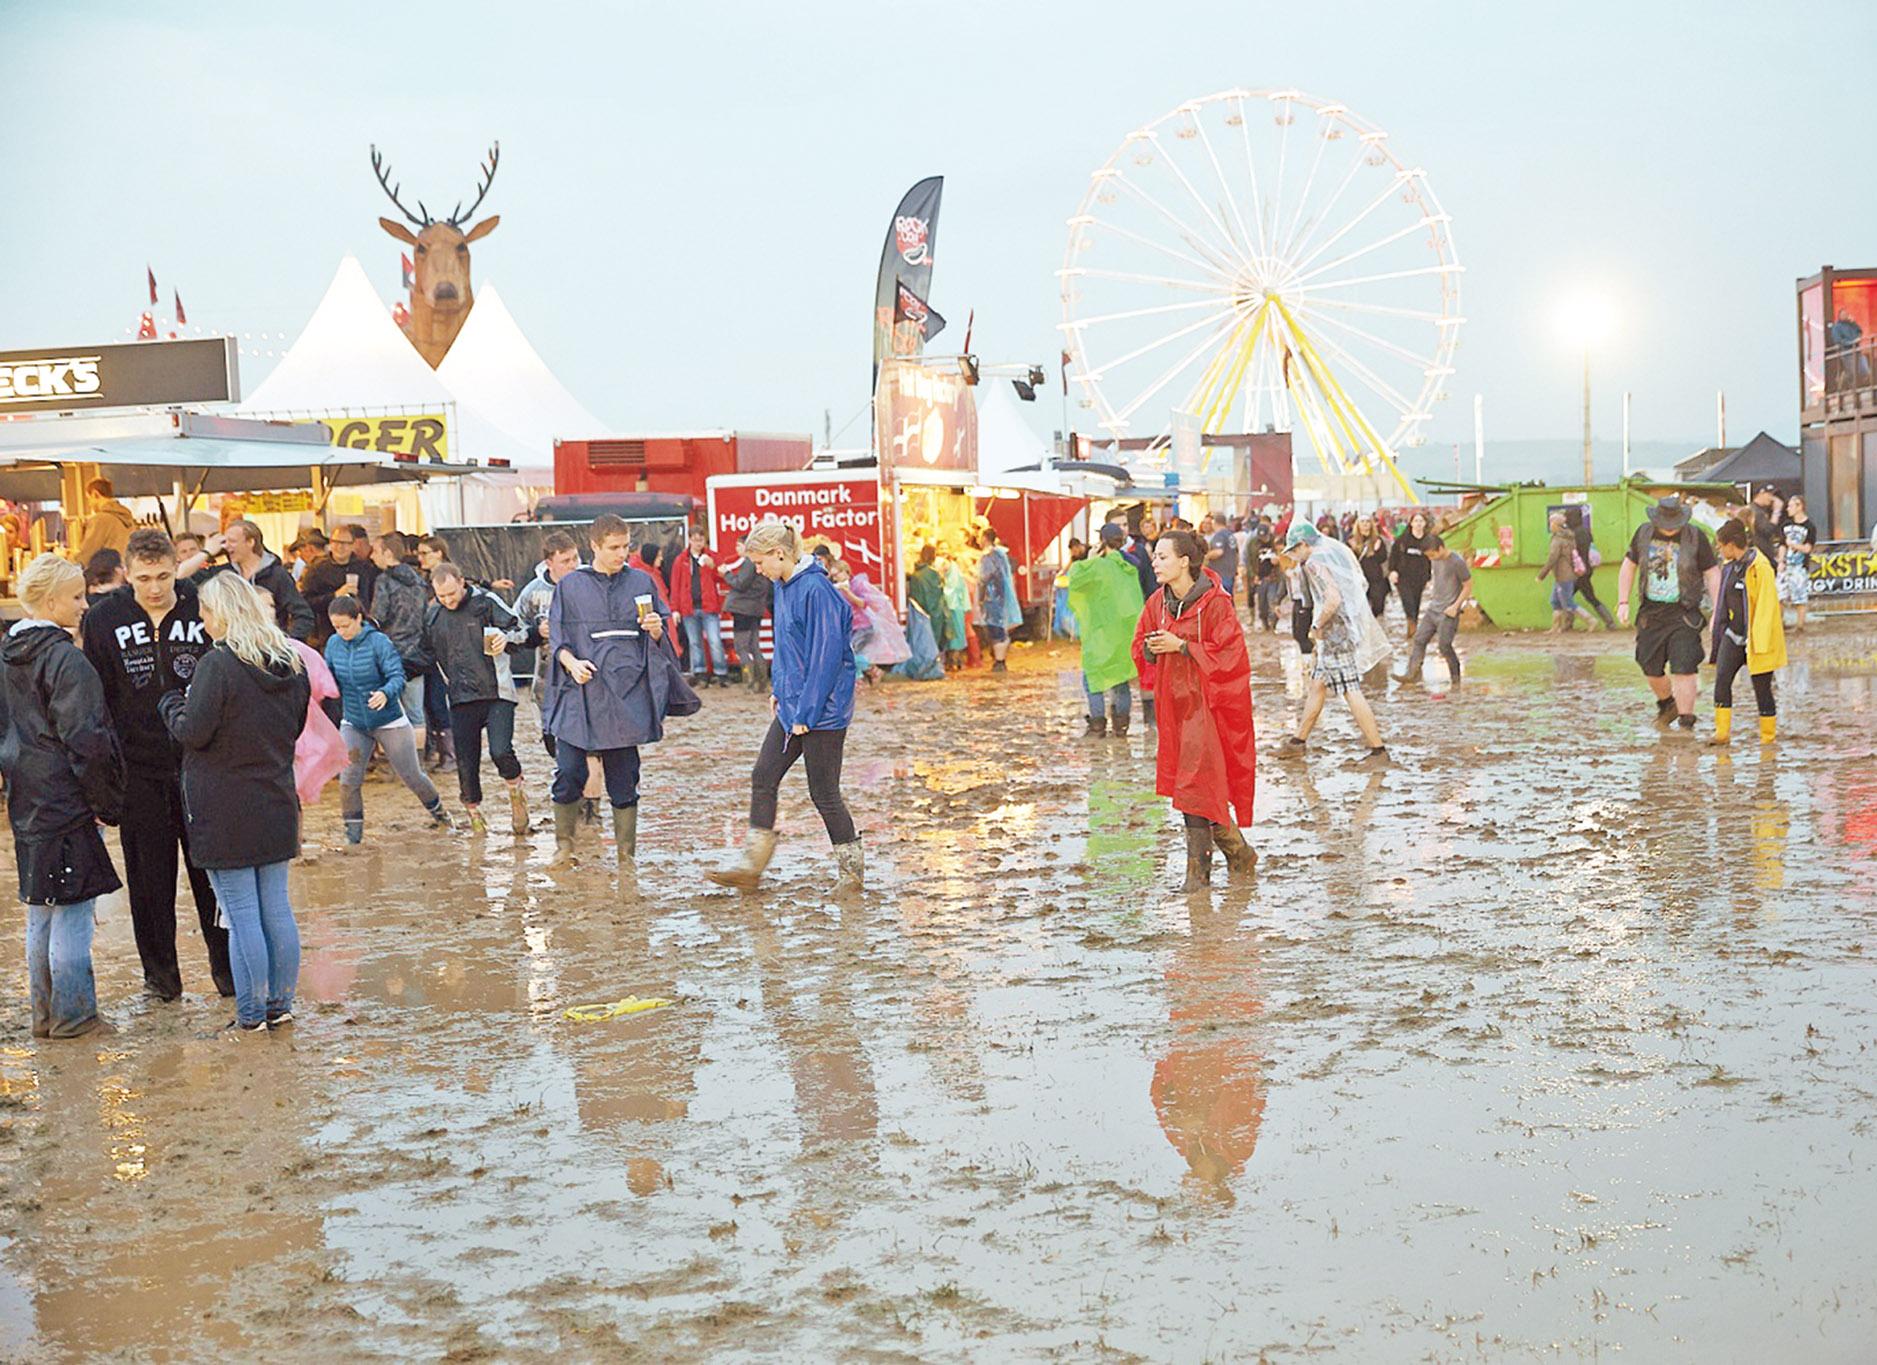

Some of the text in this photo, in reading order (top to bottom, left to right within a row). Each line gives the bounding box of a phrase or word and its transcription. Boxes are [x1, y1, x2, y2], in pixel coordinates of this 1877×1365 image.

[755, 484, 852, 507] Danmark
[720, 513, 758, 532] Hot
[811, 508, 879, 529] Factor
